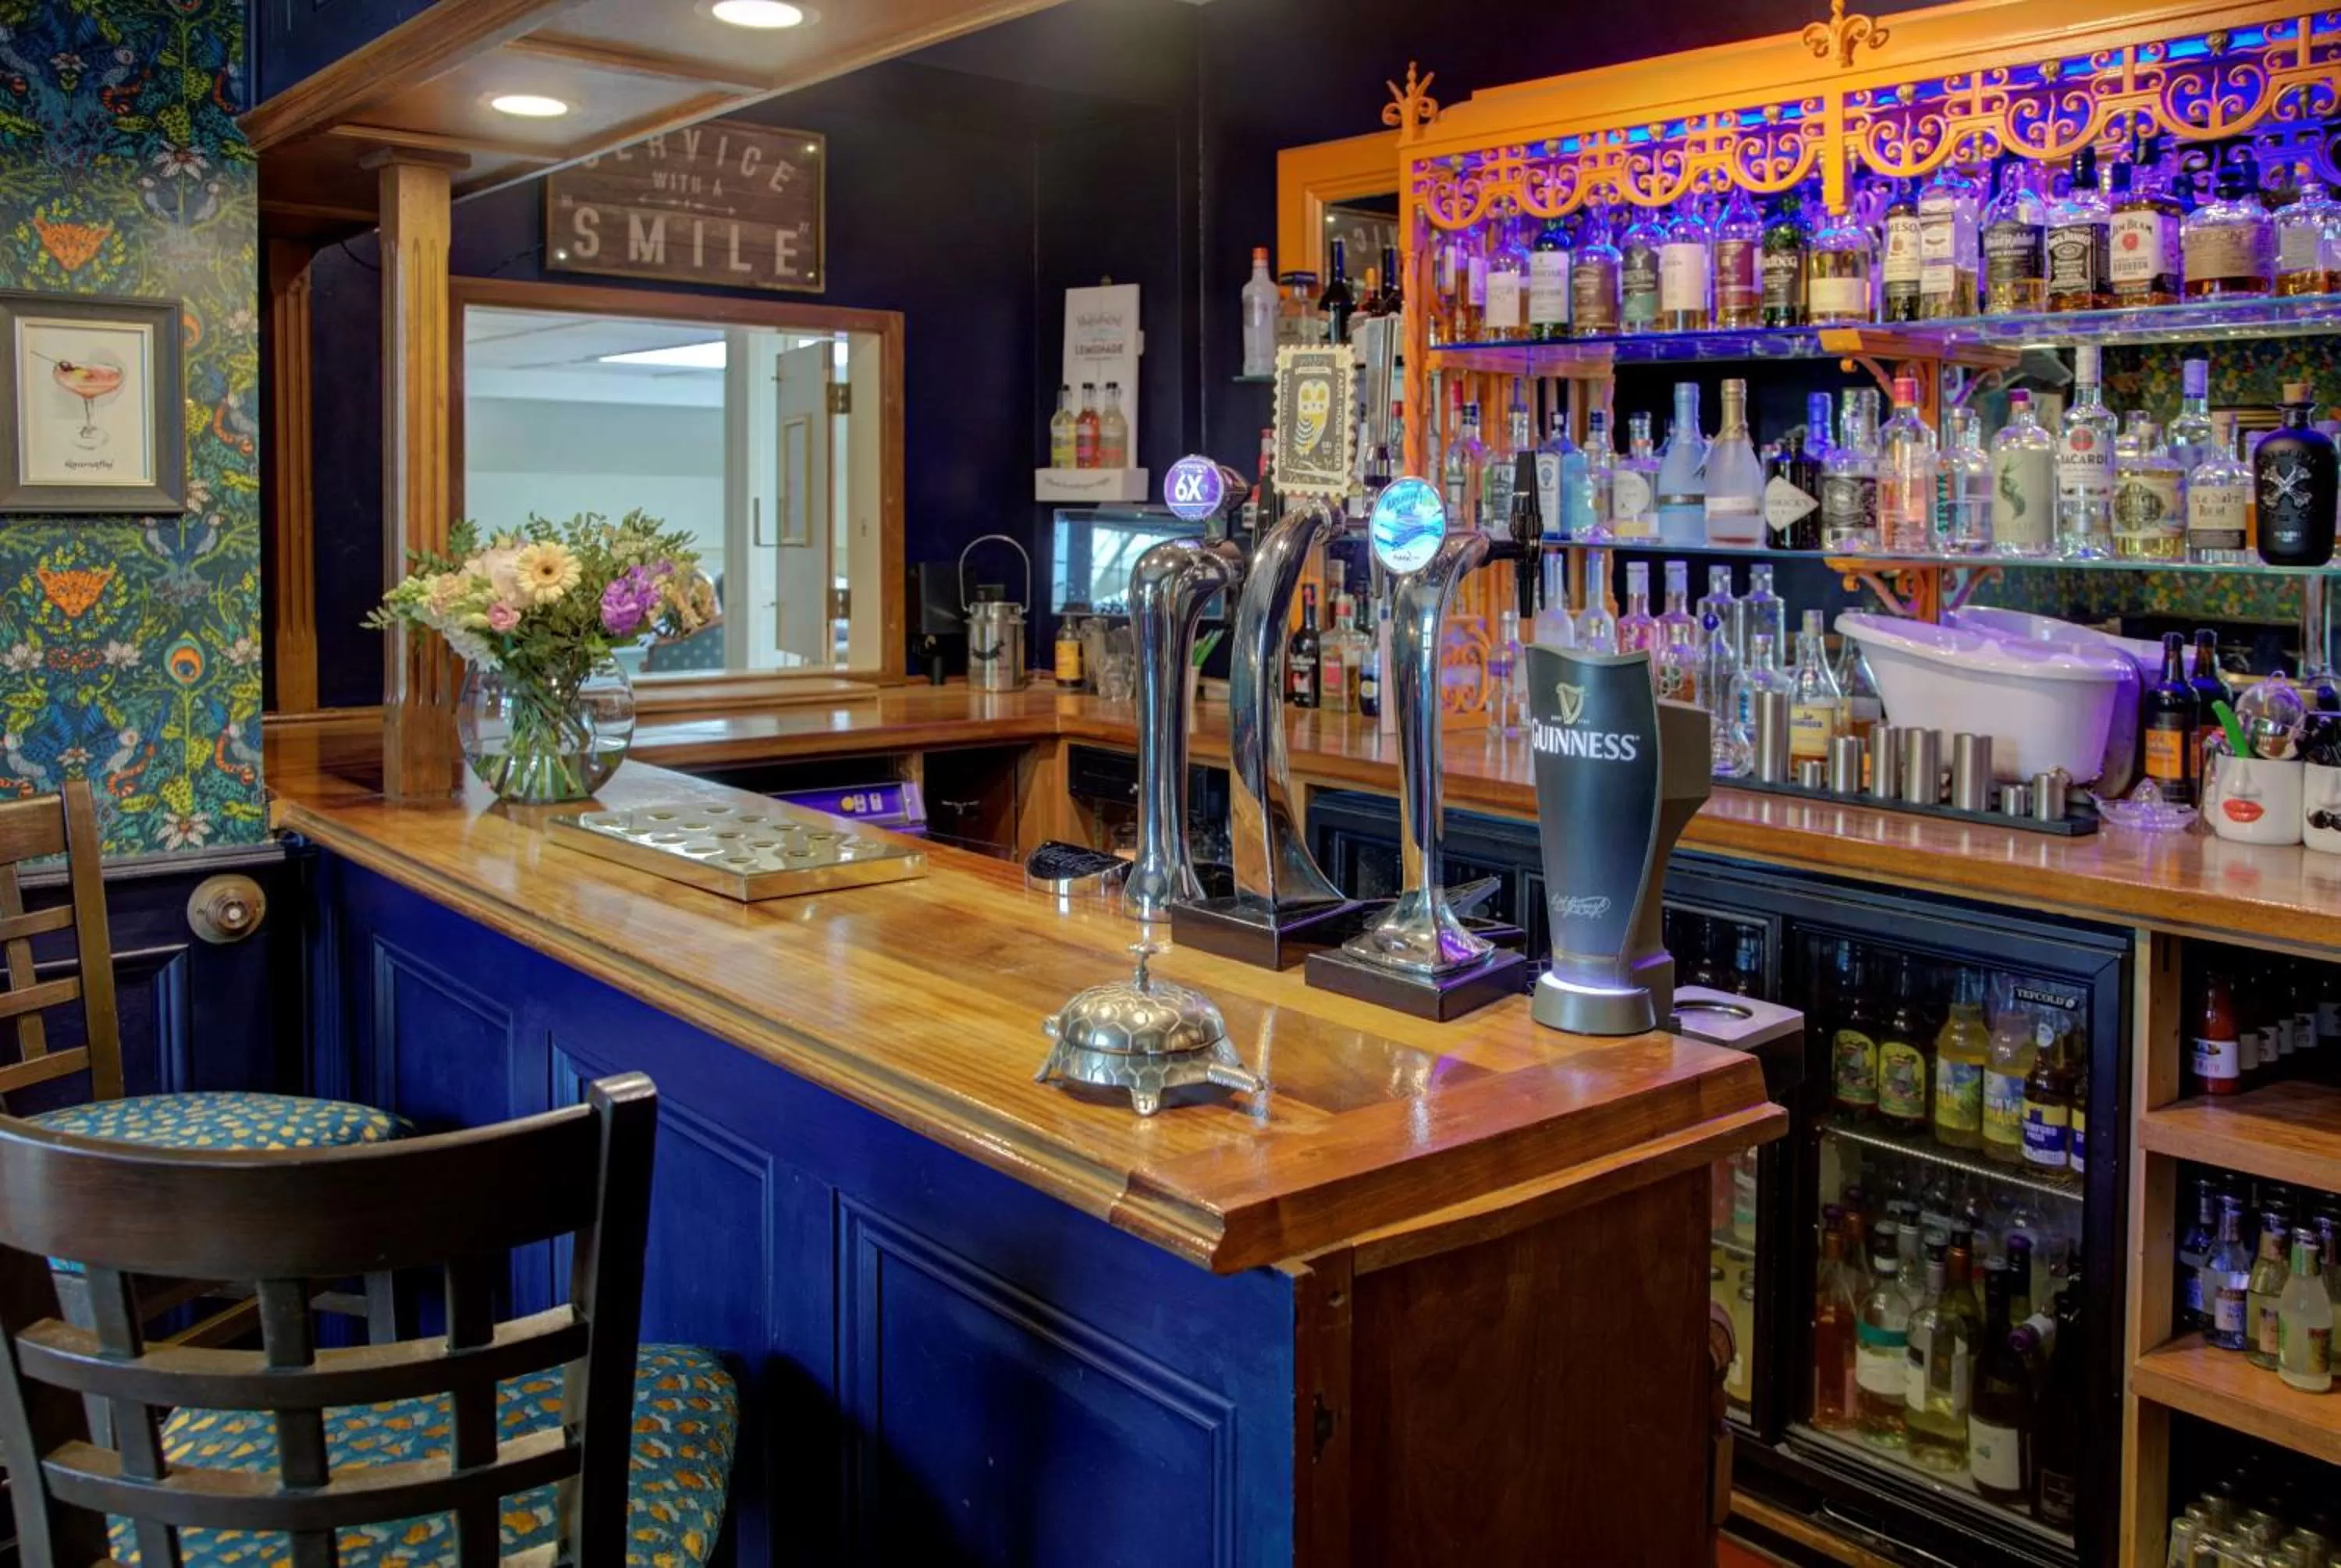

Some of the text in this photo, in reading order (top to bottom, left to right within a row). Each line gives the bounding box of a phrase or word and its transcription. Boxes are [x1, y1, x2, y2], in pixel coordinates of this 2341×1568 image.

[652, 171, 723, 197] WITH A
[1175, 474, 1203, 502] 6X
[1532, 717, 1637, 761] GUINNESS
[2016, 988, 2065, 1006] TEFCOLD
